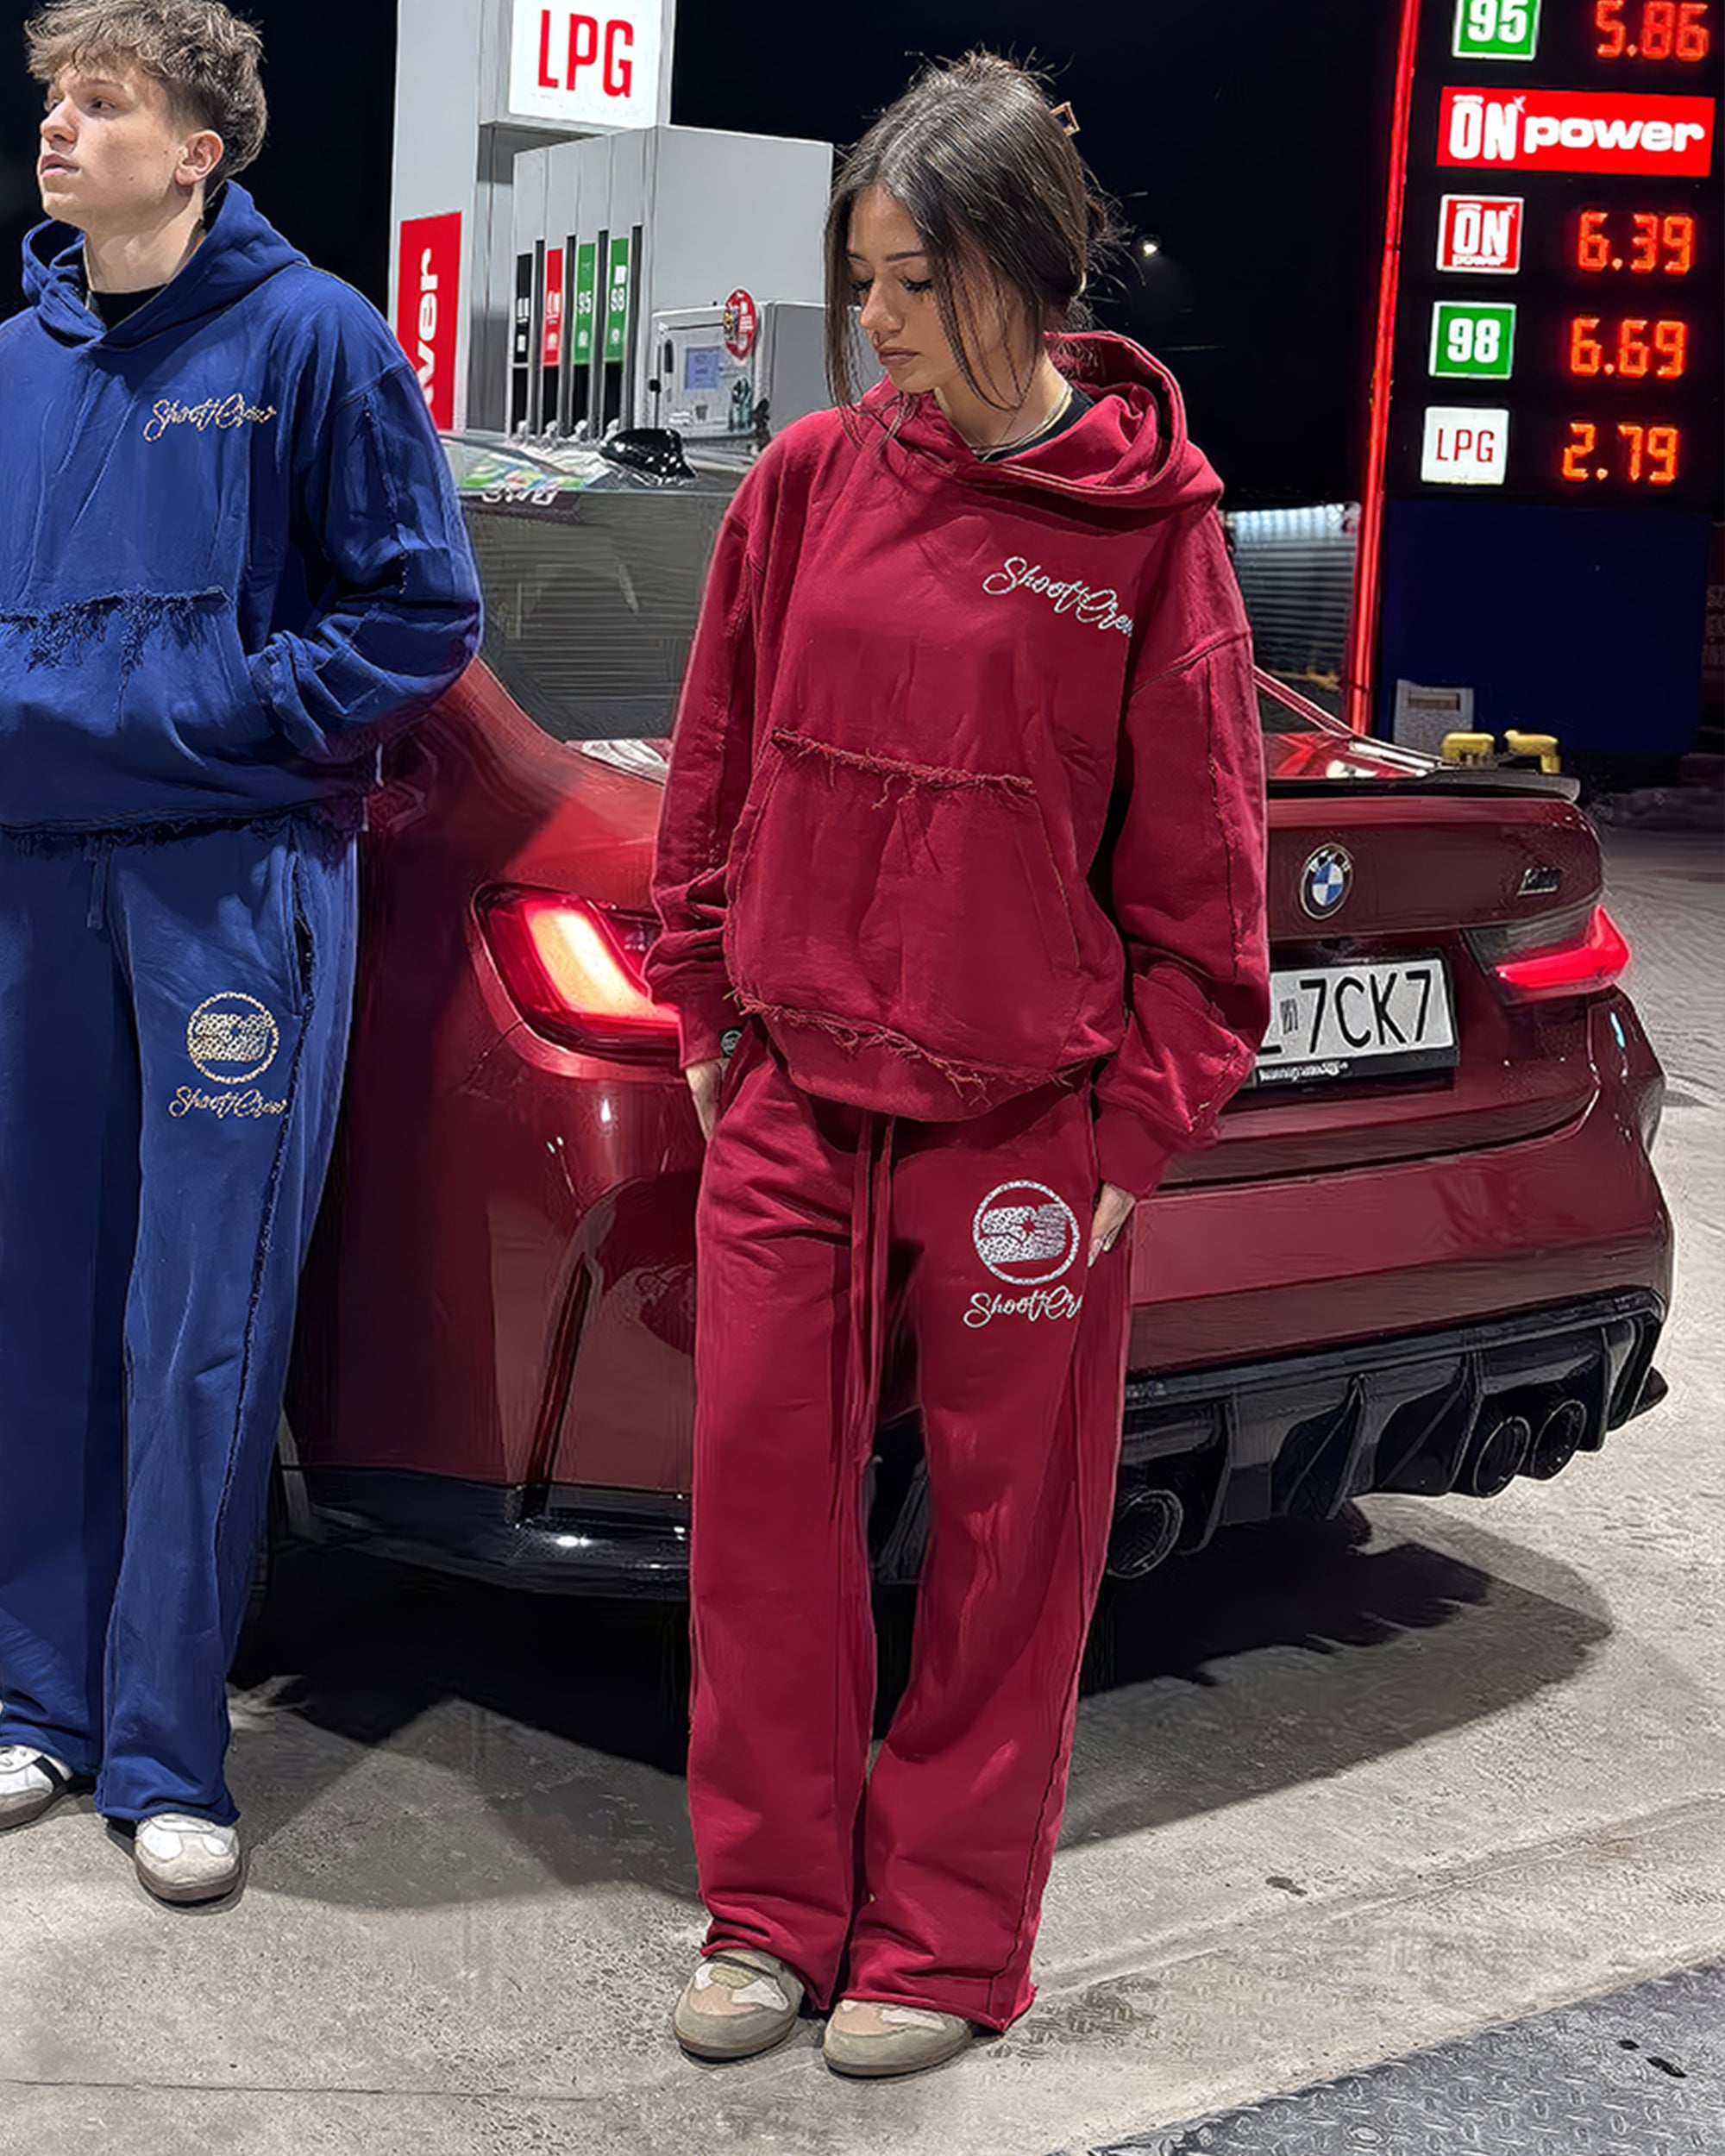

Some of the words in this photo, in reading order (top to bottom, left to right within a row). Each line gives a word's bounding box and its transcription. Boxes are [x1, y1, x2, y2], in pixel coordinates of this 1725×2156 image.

[1467, 0, 1527, 43] 95
[1596, 0, 1709, 61] 5.86
[537, 9, 634, 98] LPG
[1523, 116, 1705, 154] power
[1578, 210, 1694, 275] 6.39
[578, 290, 593, 315] 95
[1446, 317, 1501, 363] 98
[1571, 317, 1687, 379] 6.69
[1436, 428, 1495, 463] LPG
[1561, 422, 1680, 482] 2.79
[1300, 969, 1432, 1055] 7CK7
